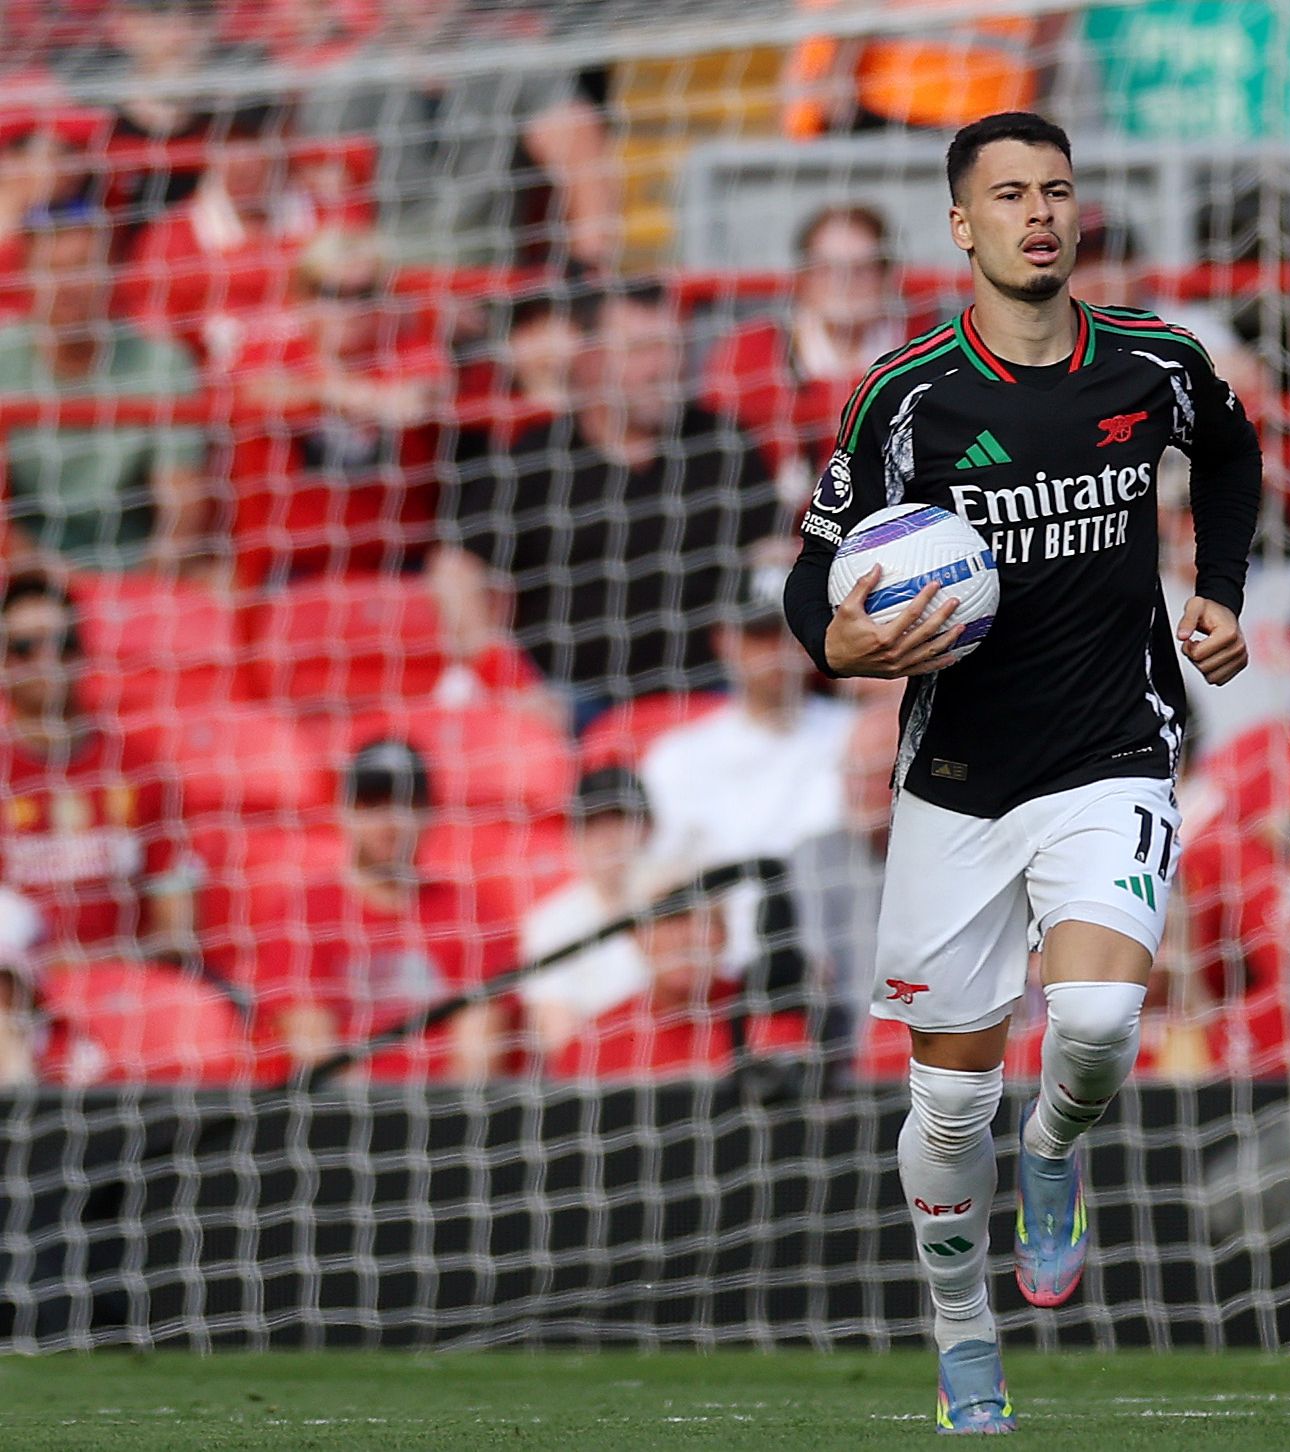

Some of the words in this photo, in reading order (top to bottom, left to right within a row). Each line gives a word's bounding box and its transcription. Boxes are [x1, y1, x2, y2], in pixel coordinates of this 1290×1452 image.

[949, 463, 1151, 525] Emirates
[810, 513, 842, 535] room
[991, 527, 1035, 563] FLY
[1045, 510, 1129, 560] BETTER
[1134, 804, 1174, 881] 11
[914, 1198, 973, 1216] AFC
